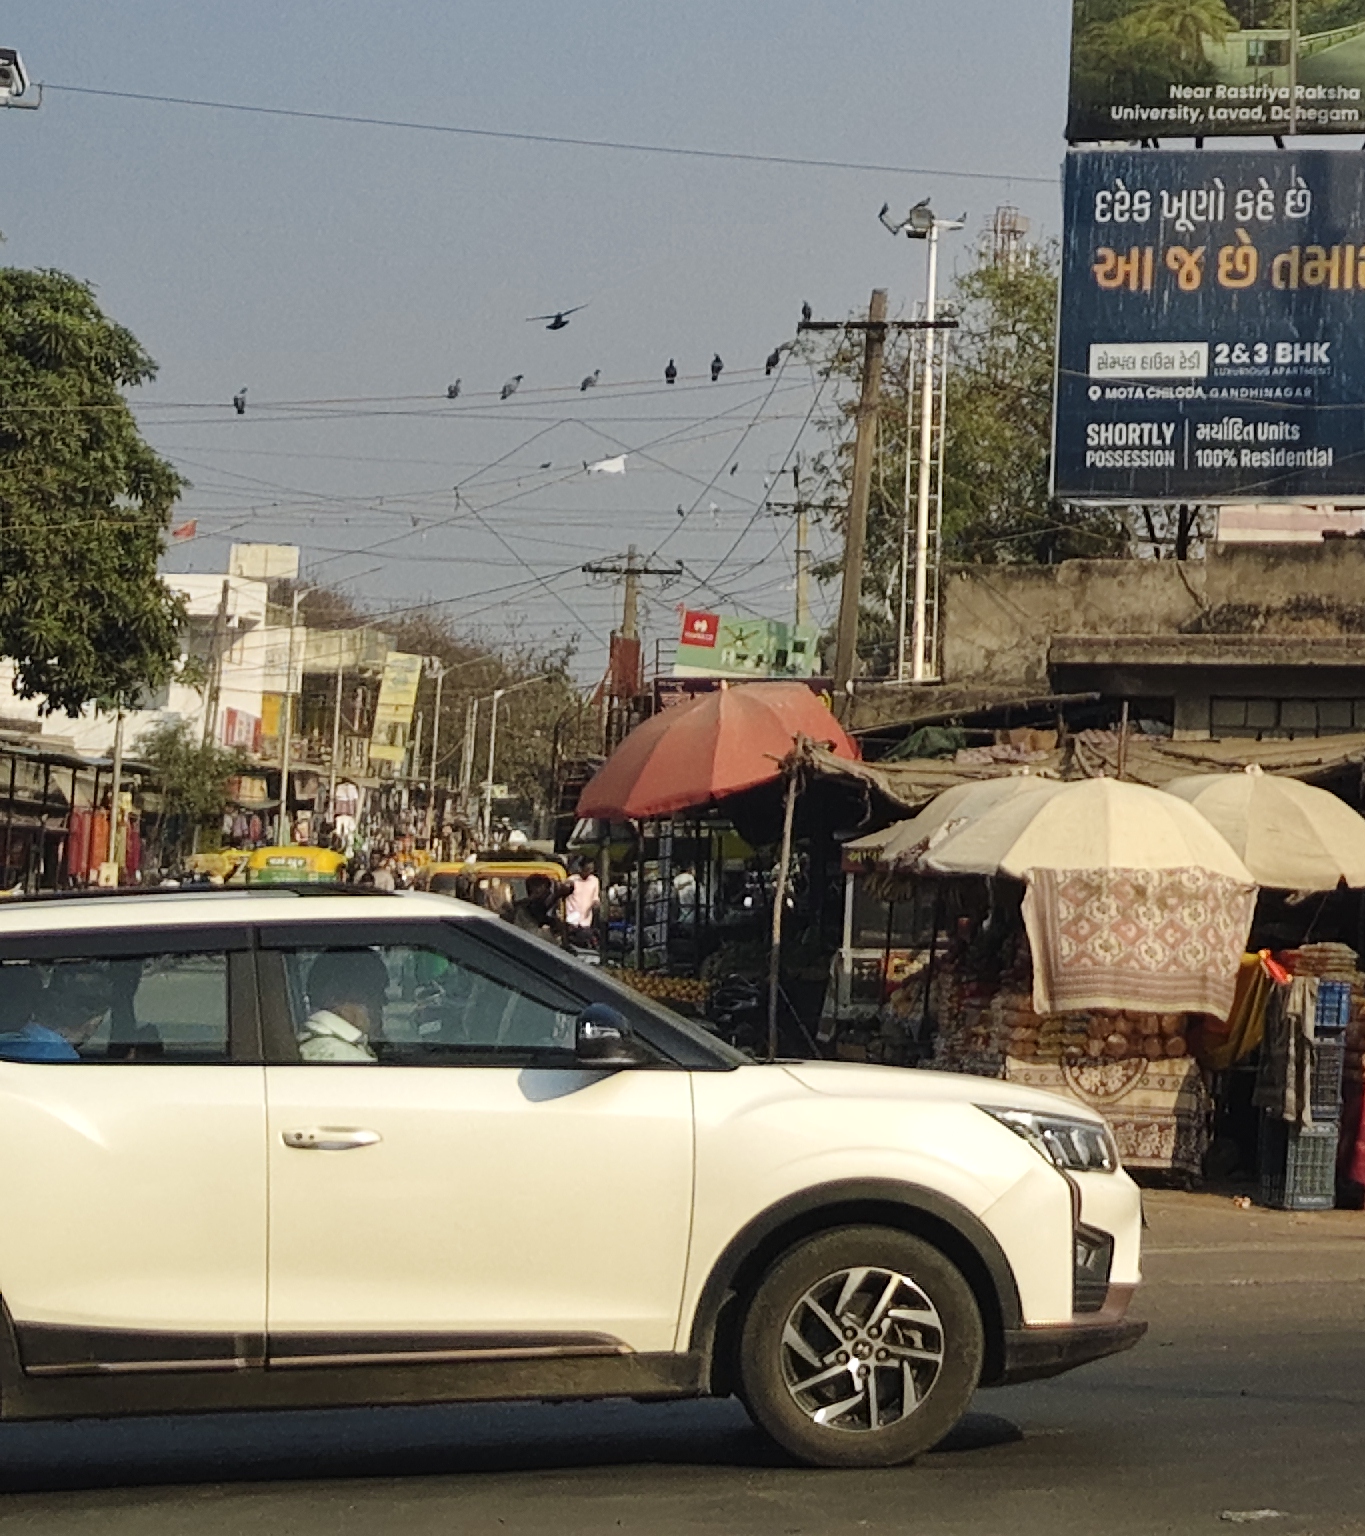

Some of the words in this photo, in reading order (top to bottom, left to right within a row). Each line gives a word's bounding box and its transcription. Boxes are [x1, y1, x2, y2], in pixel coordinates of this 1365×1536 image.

[1169, 84, 1212, 99] Near
[1215, 83, 1289, 102] Rastriya
[1294, 84, 1361, 100] Raksha
[1110, 104, 1205, 124] University,
[1208, 105, 1267, 121] Lavad,
[1094, 178, 1151, 223] દરેક
[1159, 178, 1225, 232] ખૂણો
[1234, 178, 1275, 222] કહે
[1284, 176, 1311, 219] છે
[1093, 244, 1153, 292] આ
[1166, 245, 1206, 291] જ
[1217, 228, 1260, 290] છે
[1140, 351, 1175, 370] હાઉસ
[1275, 341, 1331, 364] BHK
[1105, 386, 1144, 400] MOTA
[1210, 386, 1313, 399] GANDHINAGAR
[1086, 422, 1175, 447] SHORTLY
[1258, 422, 1300, 441] Units
[1086, 449, 1175, 468] POSSESSION
[1196, 448, 1237, 468] 100%
[1241, 447, 1333, 468] Residential
